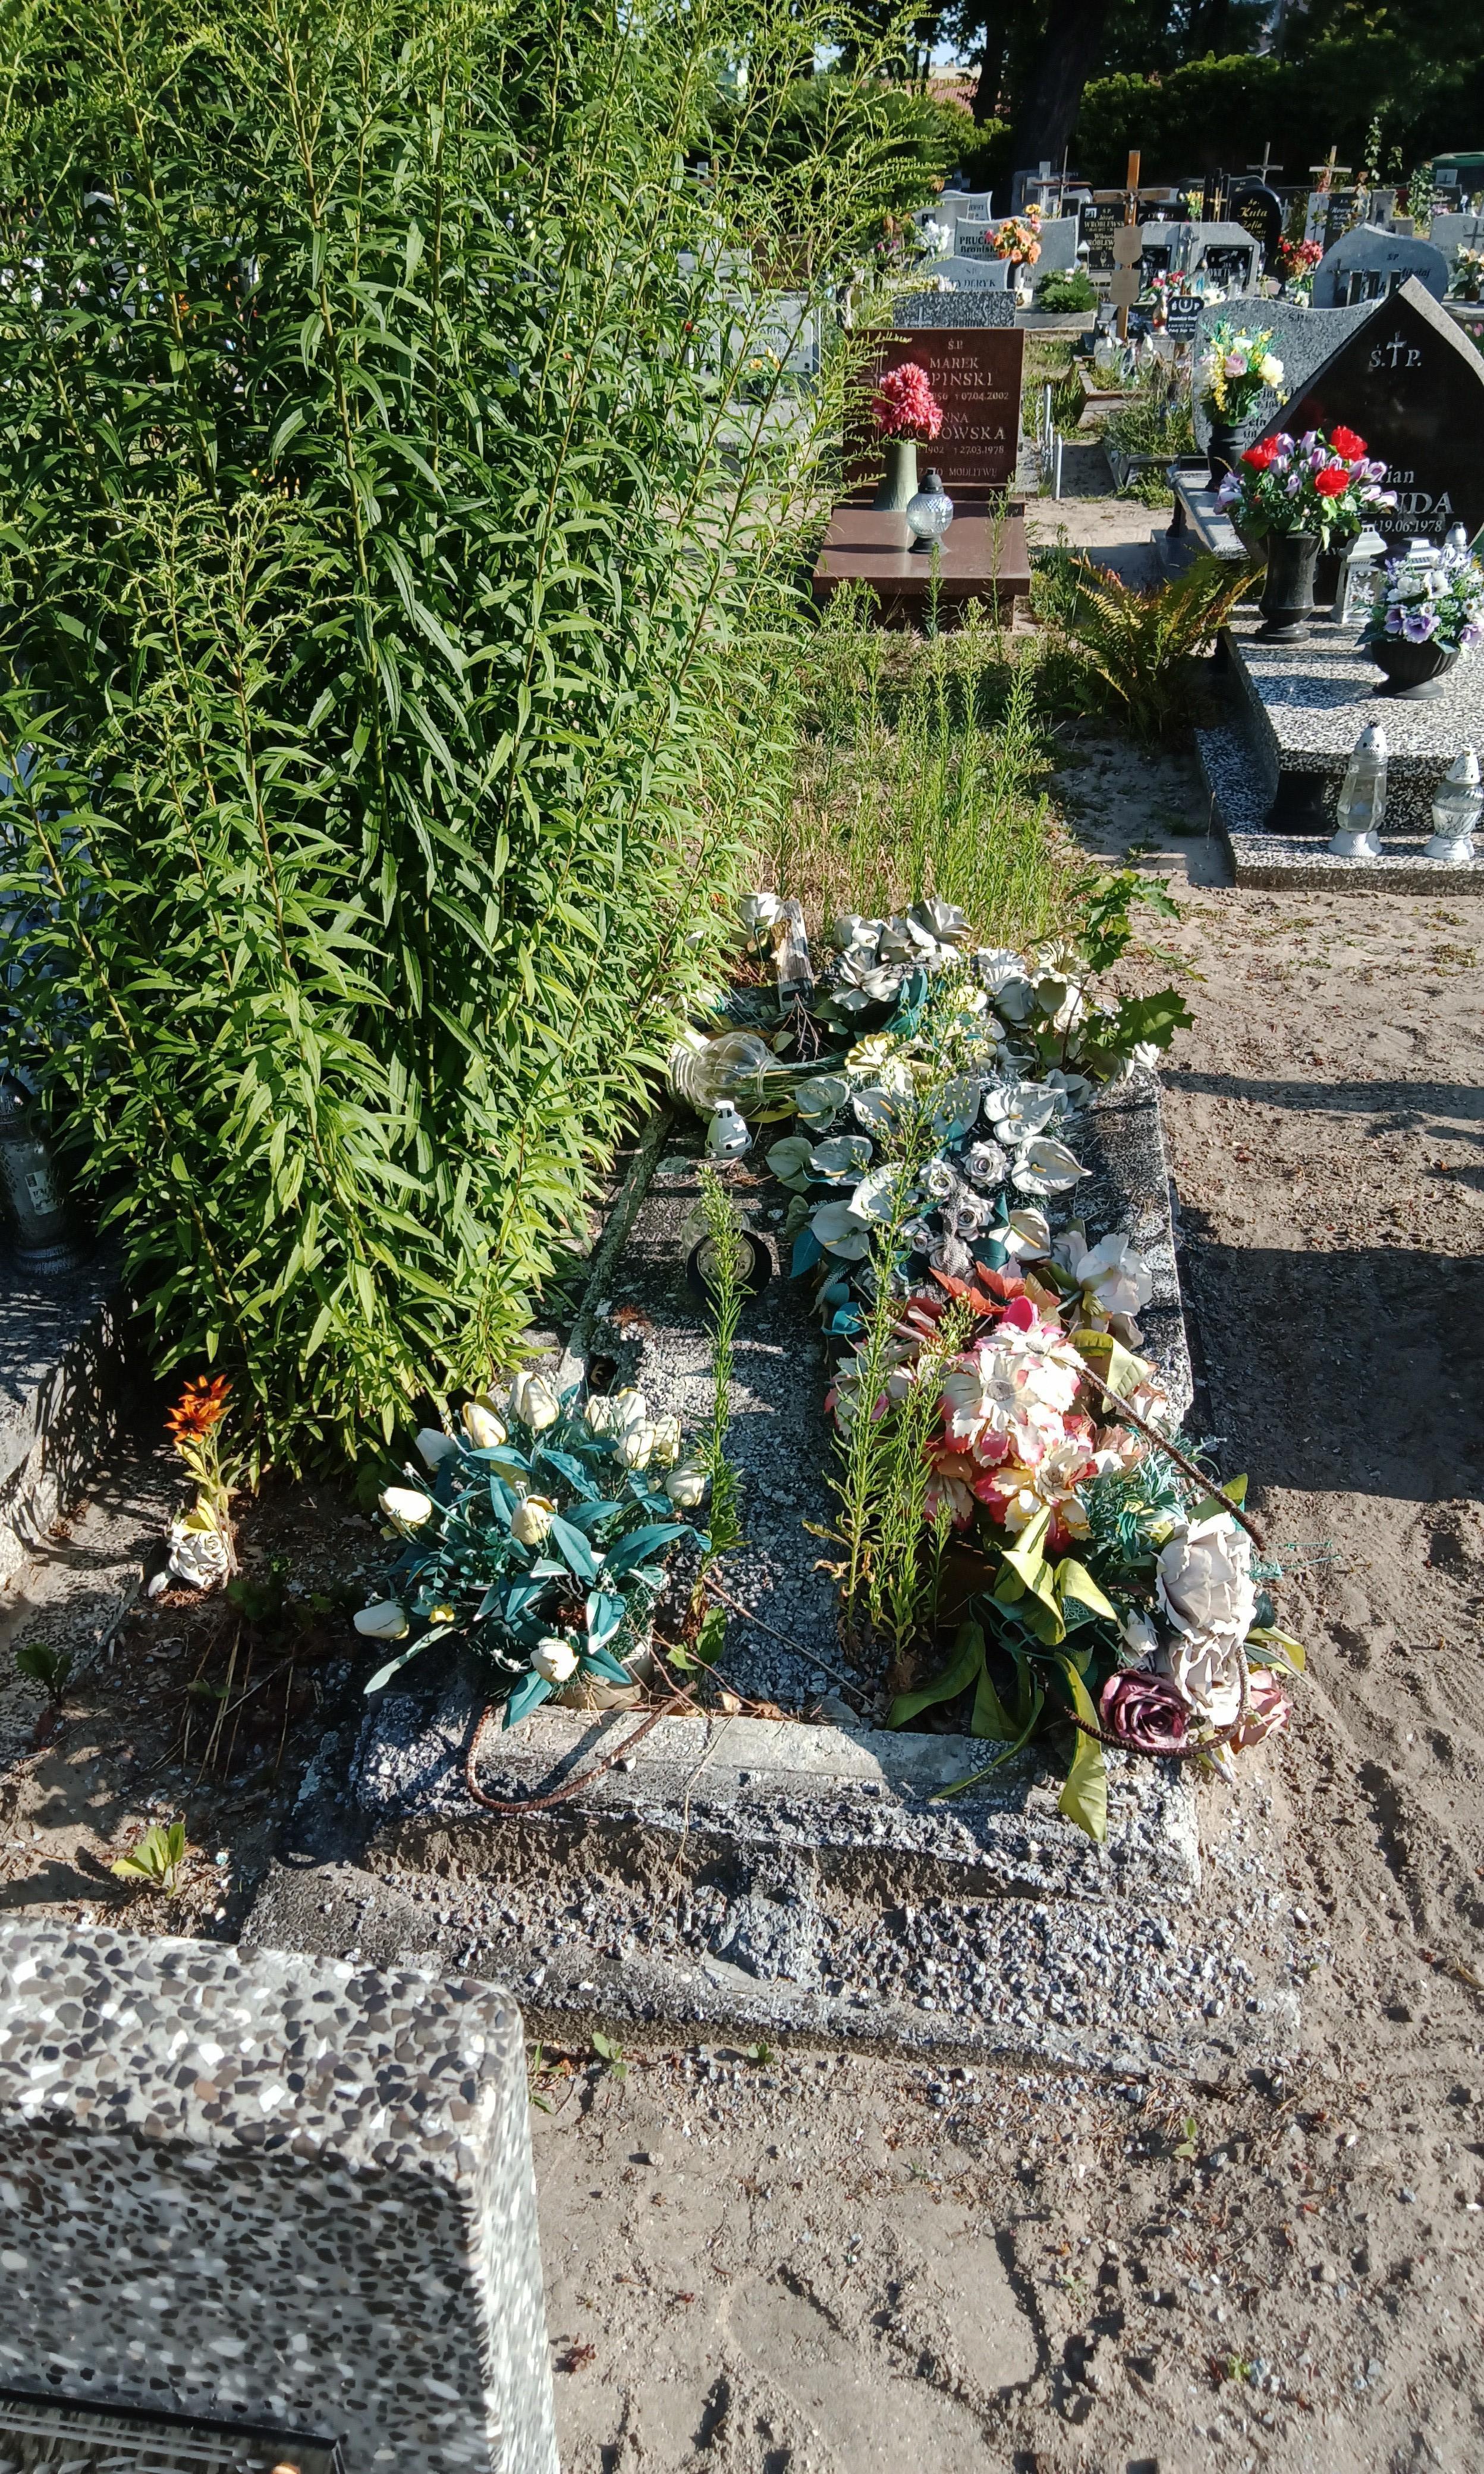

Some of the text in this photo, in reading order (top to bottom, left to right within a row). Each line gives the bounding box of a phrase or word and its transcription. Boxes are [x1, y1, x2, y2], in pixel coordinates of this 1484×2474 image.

[929, 357, 979, 369] MAREK
[941, 412, 970, 423] NNA
[1378, 519, 1443, 533] 19.06.1978
